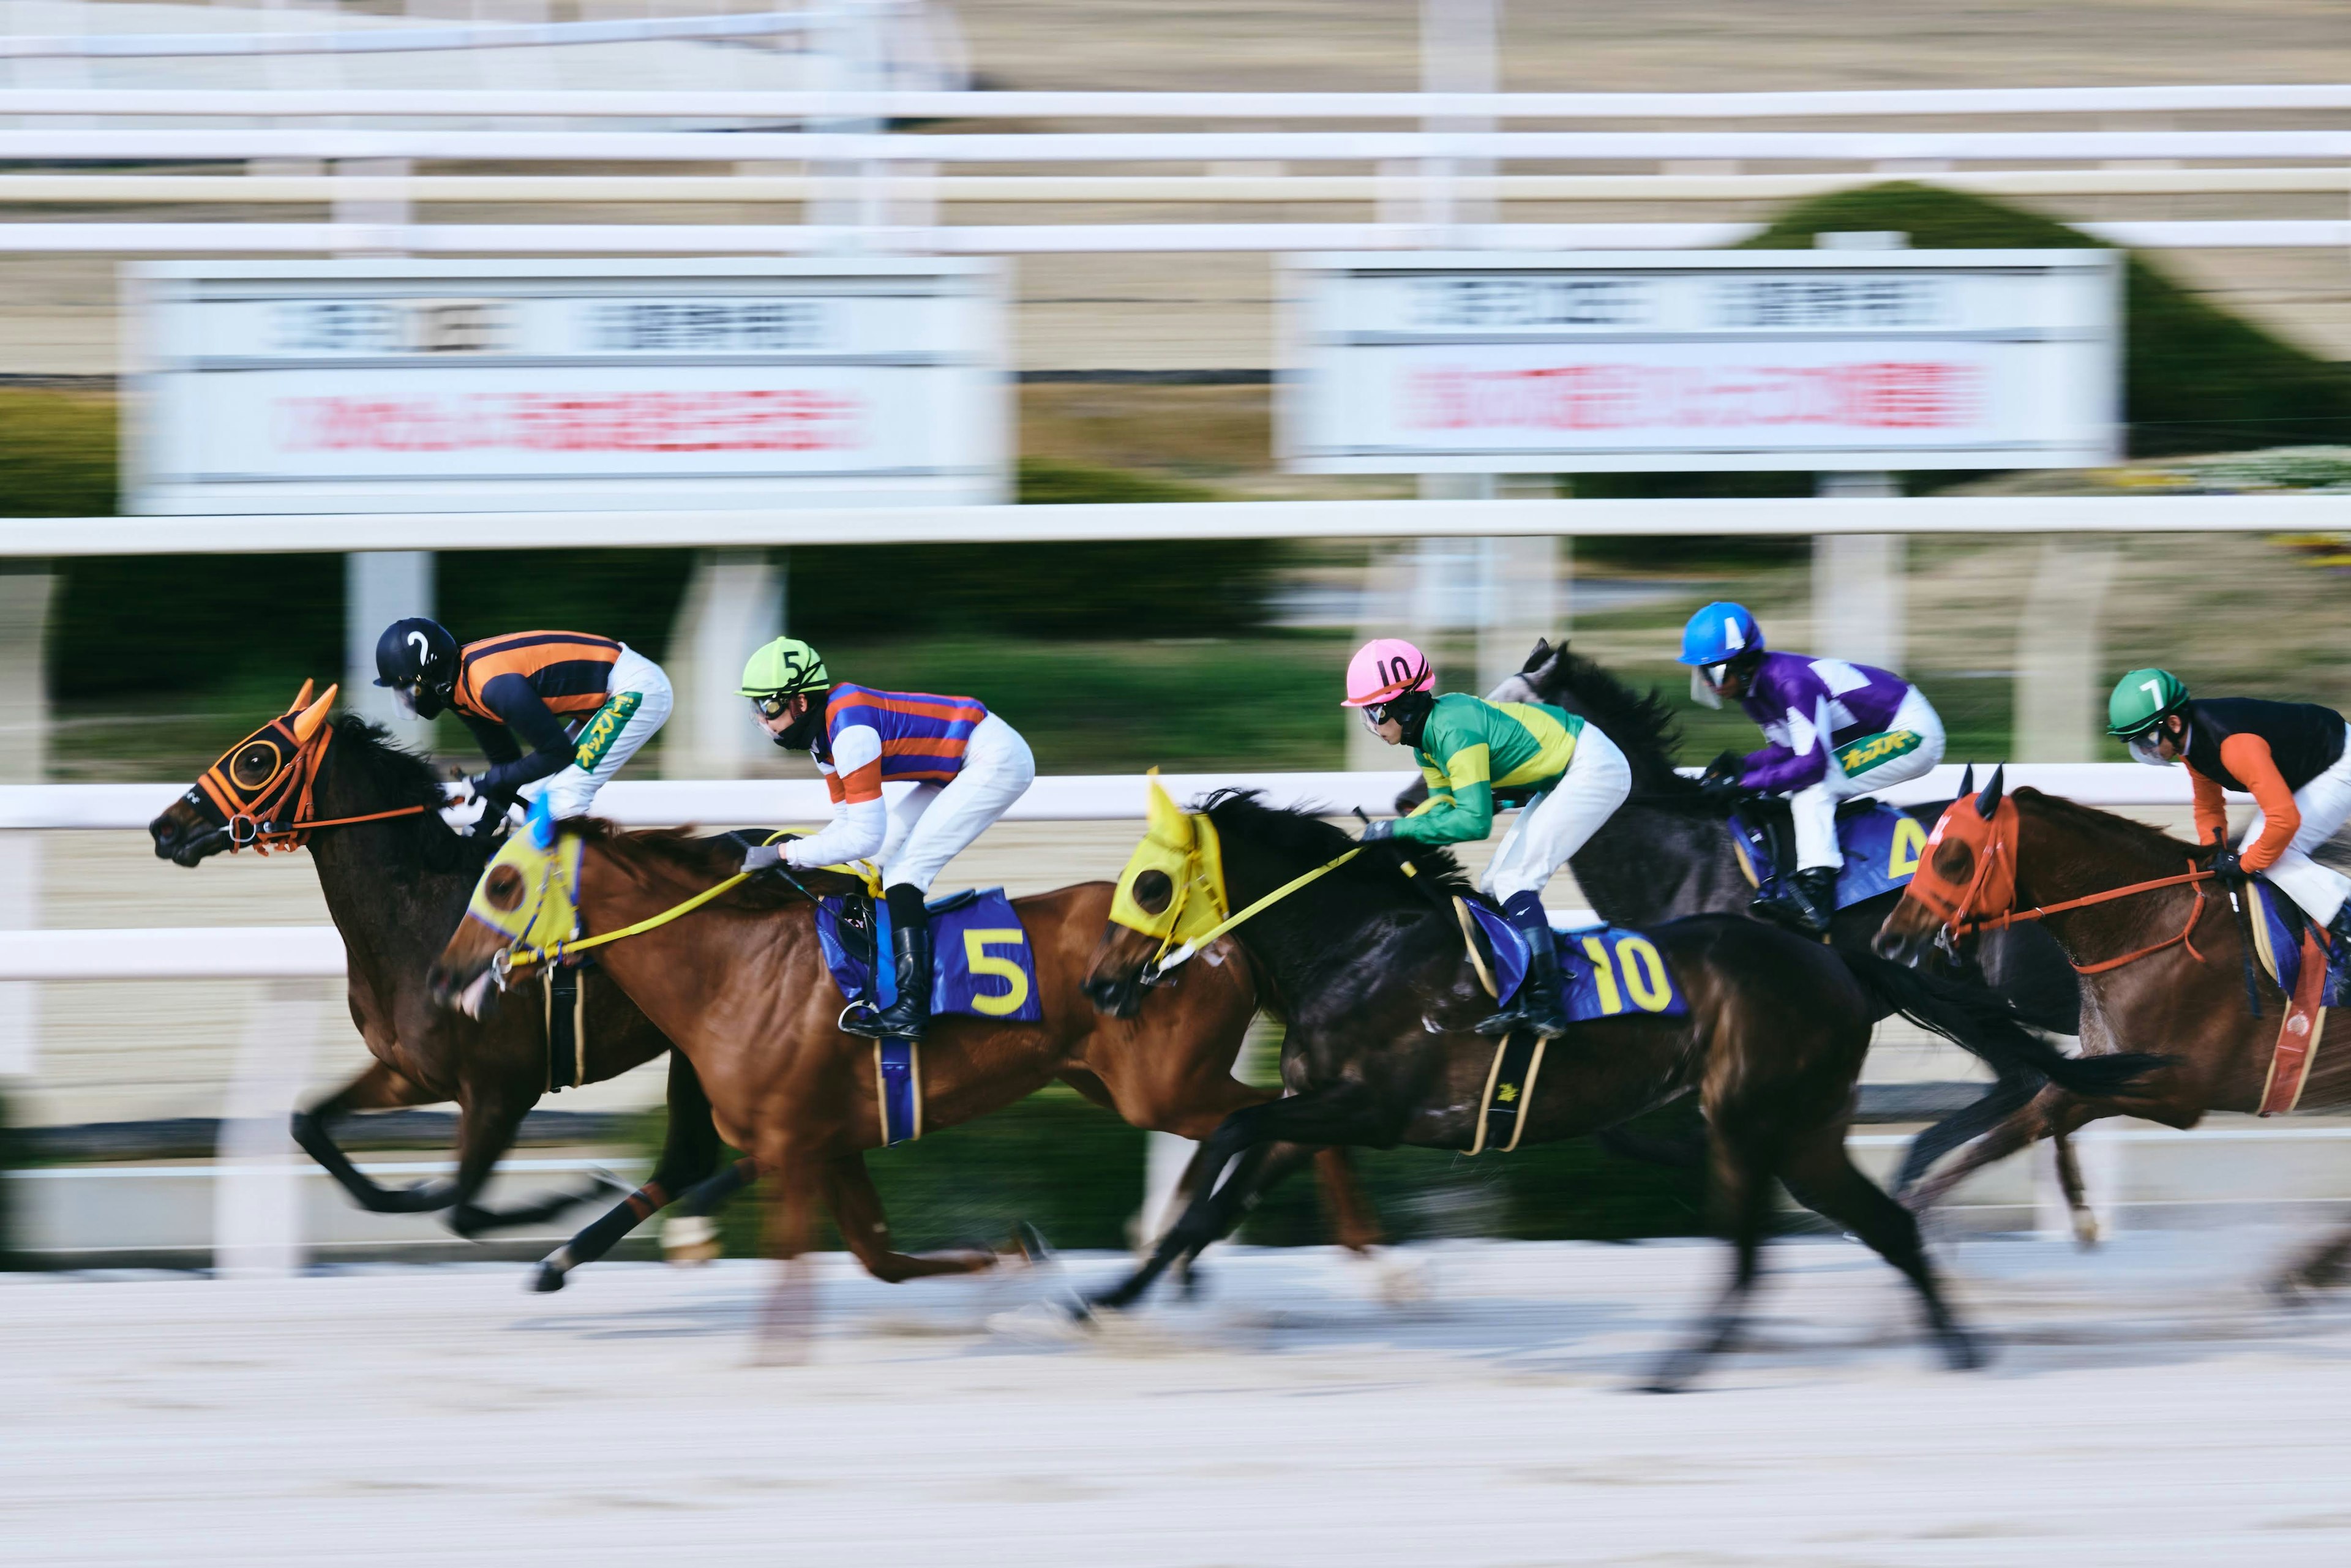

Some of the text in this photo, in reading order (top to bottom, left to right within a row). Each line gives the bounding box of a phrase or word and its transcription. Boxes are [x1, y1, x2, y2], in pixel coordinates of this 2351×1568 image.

[784, 651, 803, 684] 5
[1377, 656, 1412, 694] 10
[2139, 679, 2164, 711] 7
[963, 929, 1029, 1016] 5
[1581, 937, 1673, 1015] 10
